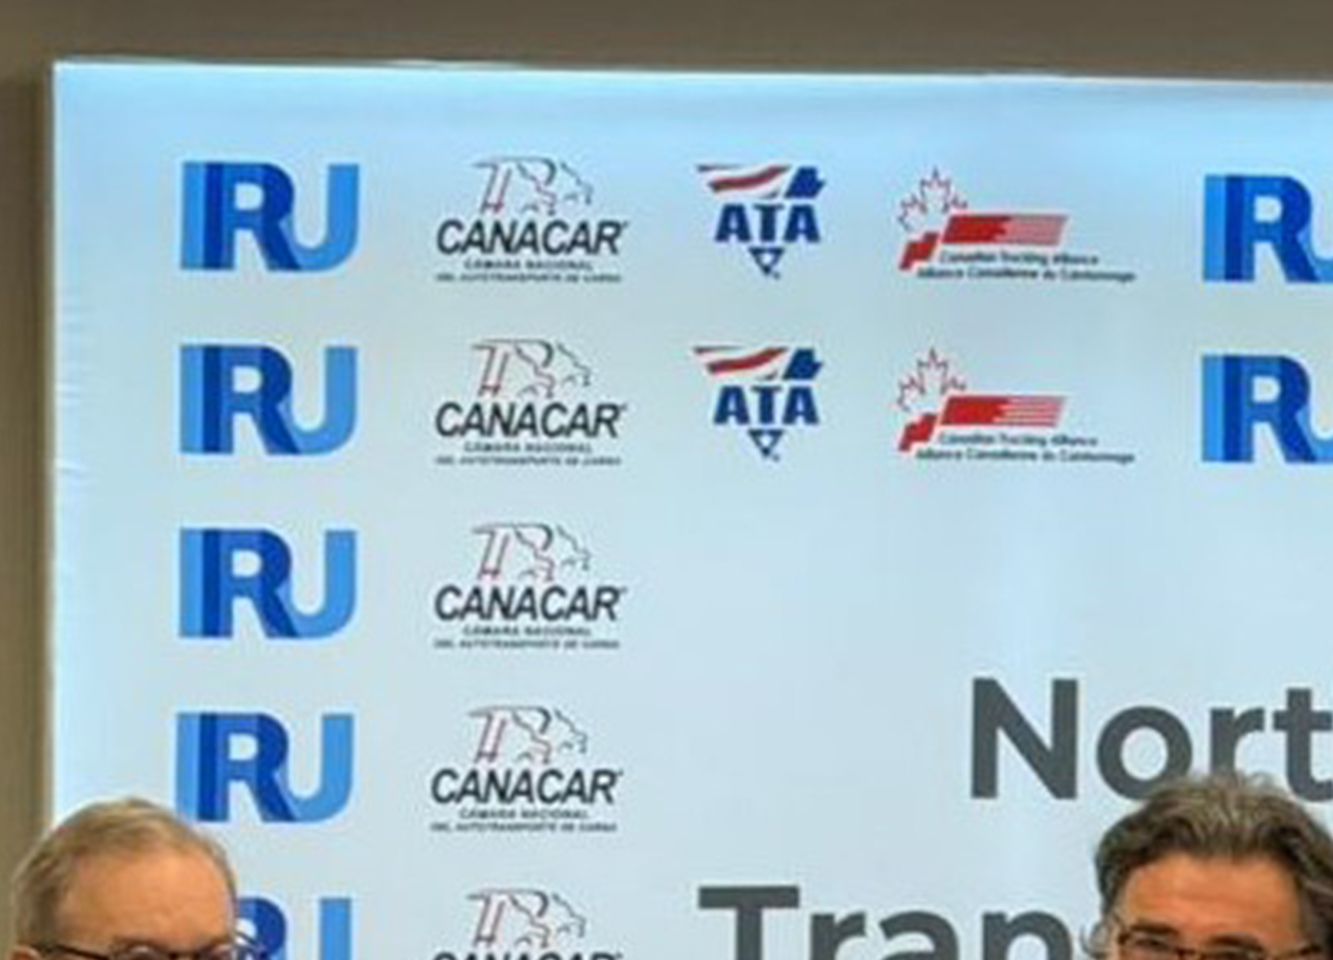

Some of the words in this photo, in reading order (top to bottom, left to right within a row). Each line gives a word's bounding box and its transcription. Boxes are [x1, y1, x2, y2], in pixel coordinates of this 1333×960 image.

[179, 162, 361, 272] IRU
[715, 204, 820, 243] ATA
[436, 219, 622, 255] CANACAR
[178, 345, 358, 456] IRU
[714, 386, 818, 424] ATA
[435, 402, 621, 438] CANACAR
[179, 529, 357, 640] IRU
[434, 585, 620, 621] CANACAR
[176, 712, 355, 823] IRU
[430, 768, 617, 804] CANACAR
